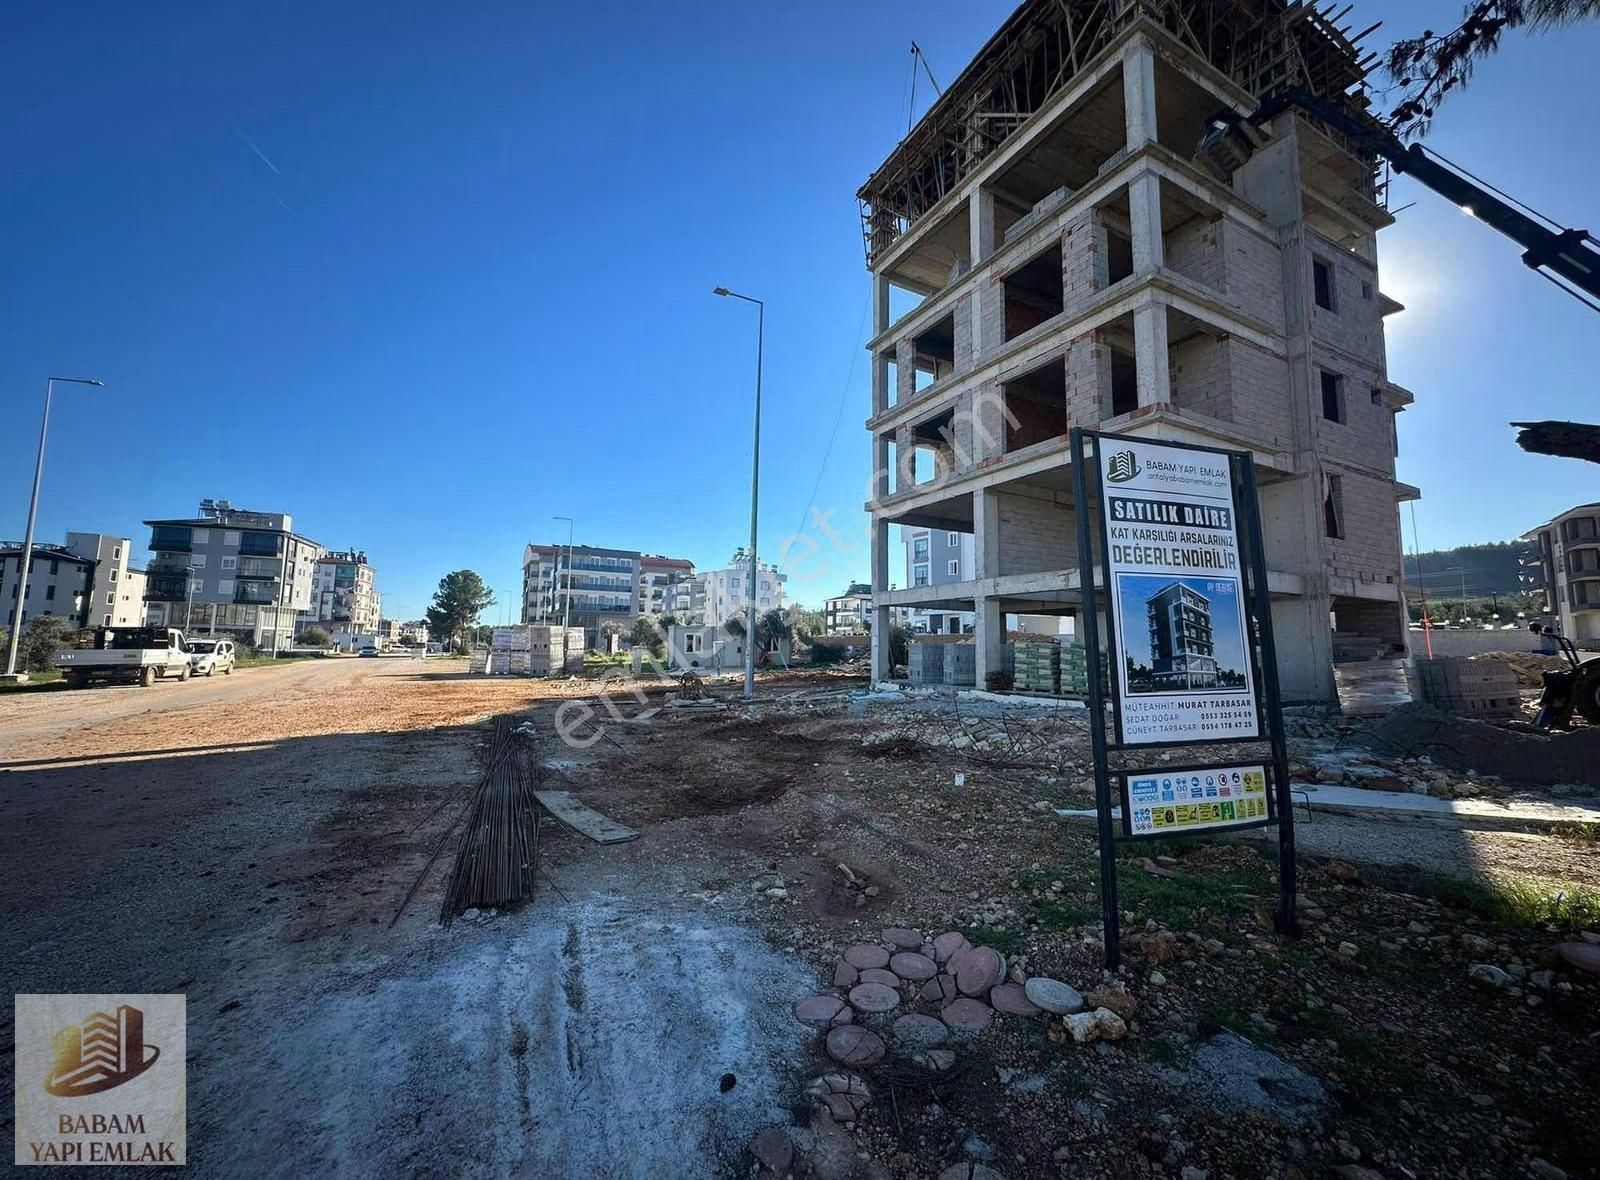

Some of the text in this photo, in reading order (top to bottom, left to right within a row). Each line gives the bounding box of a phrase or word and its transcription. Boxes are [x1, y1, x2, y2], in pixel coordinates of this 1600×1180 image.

[1146, 460, 1227, 479] BABAM YAPI EMLAK
[1114, 500, 1228, 528] SATILIK DAİRE
[1110, 527, 1129, 539] KAT
[1180, 531, 1234, 547] ARSALARINIZ
[1112, 542, 1237, 570] DEĞERLENDİRİLİR
[1178, 701, 1207, 710] MURAT
[1210, 699, 1251, 708] TARBASAR
[1126, 715, 1150, 724] SEDAT
